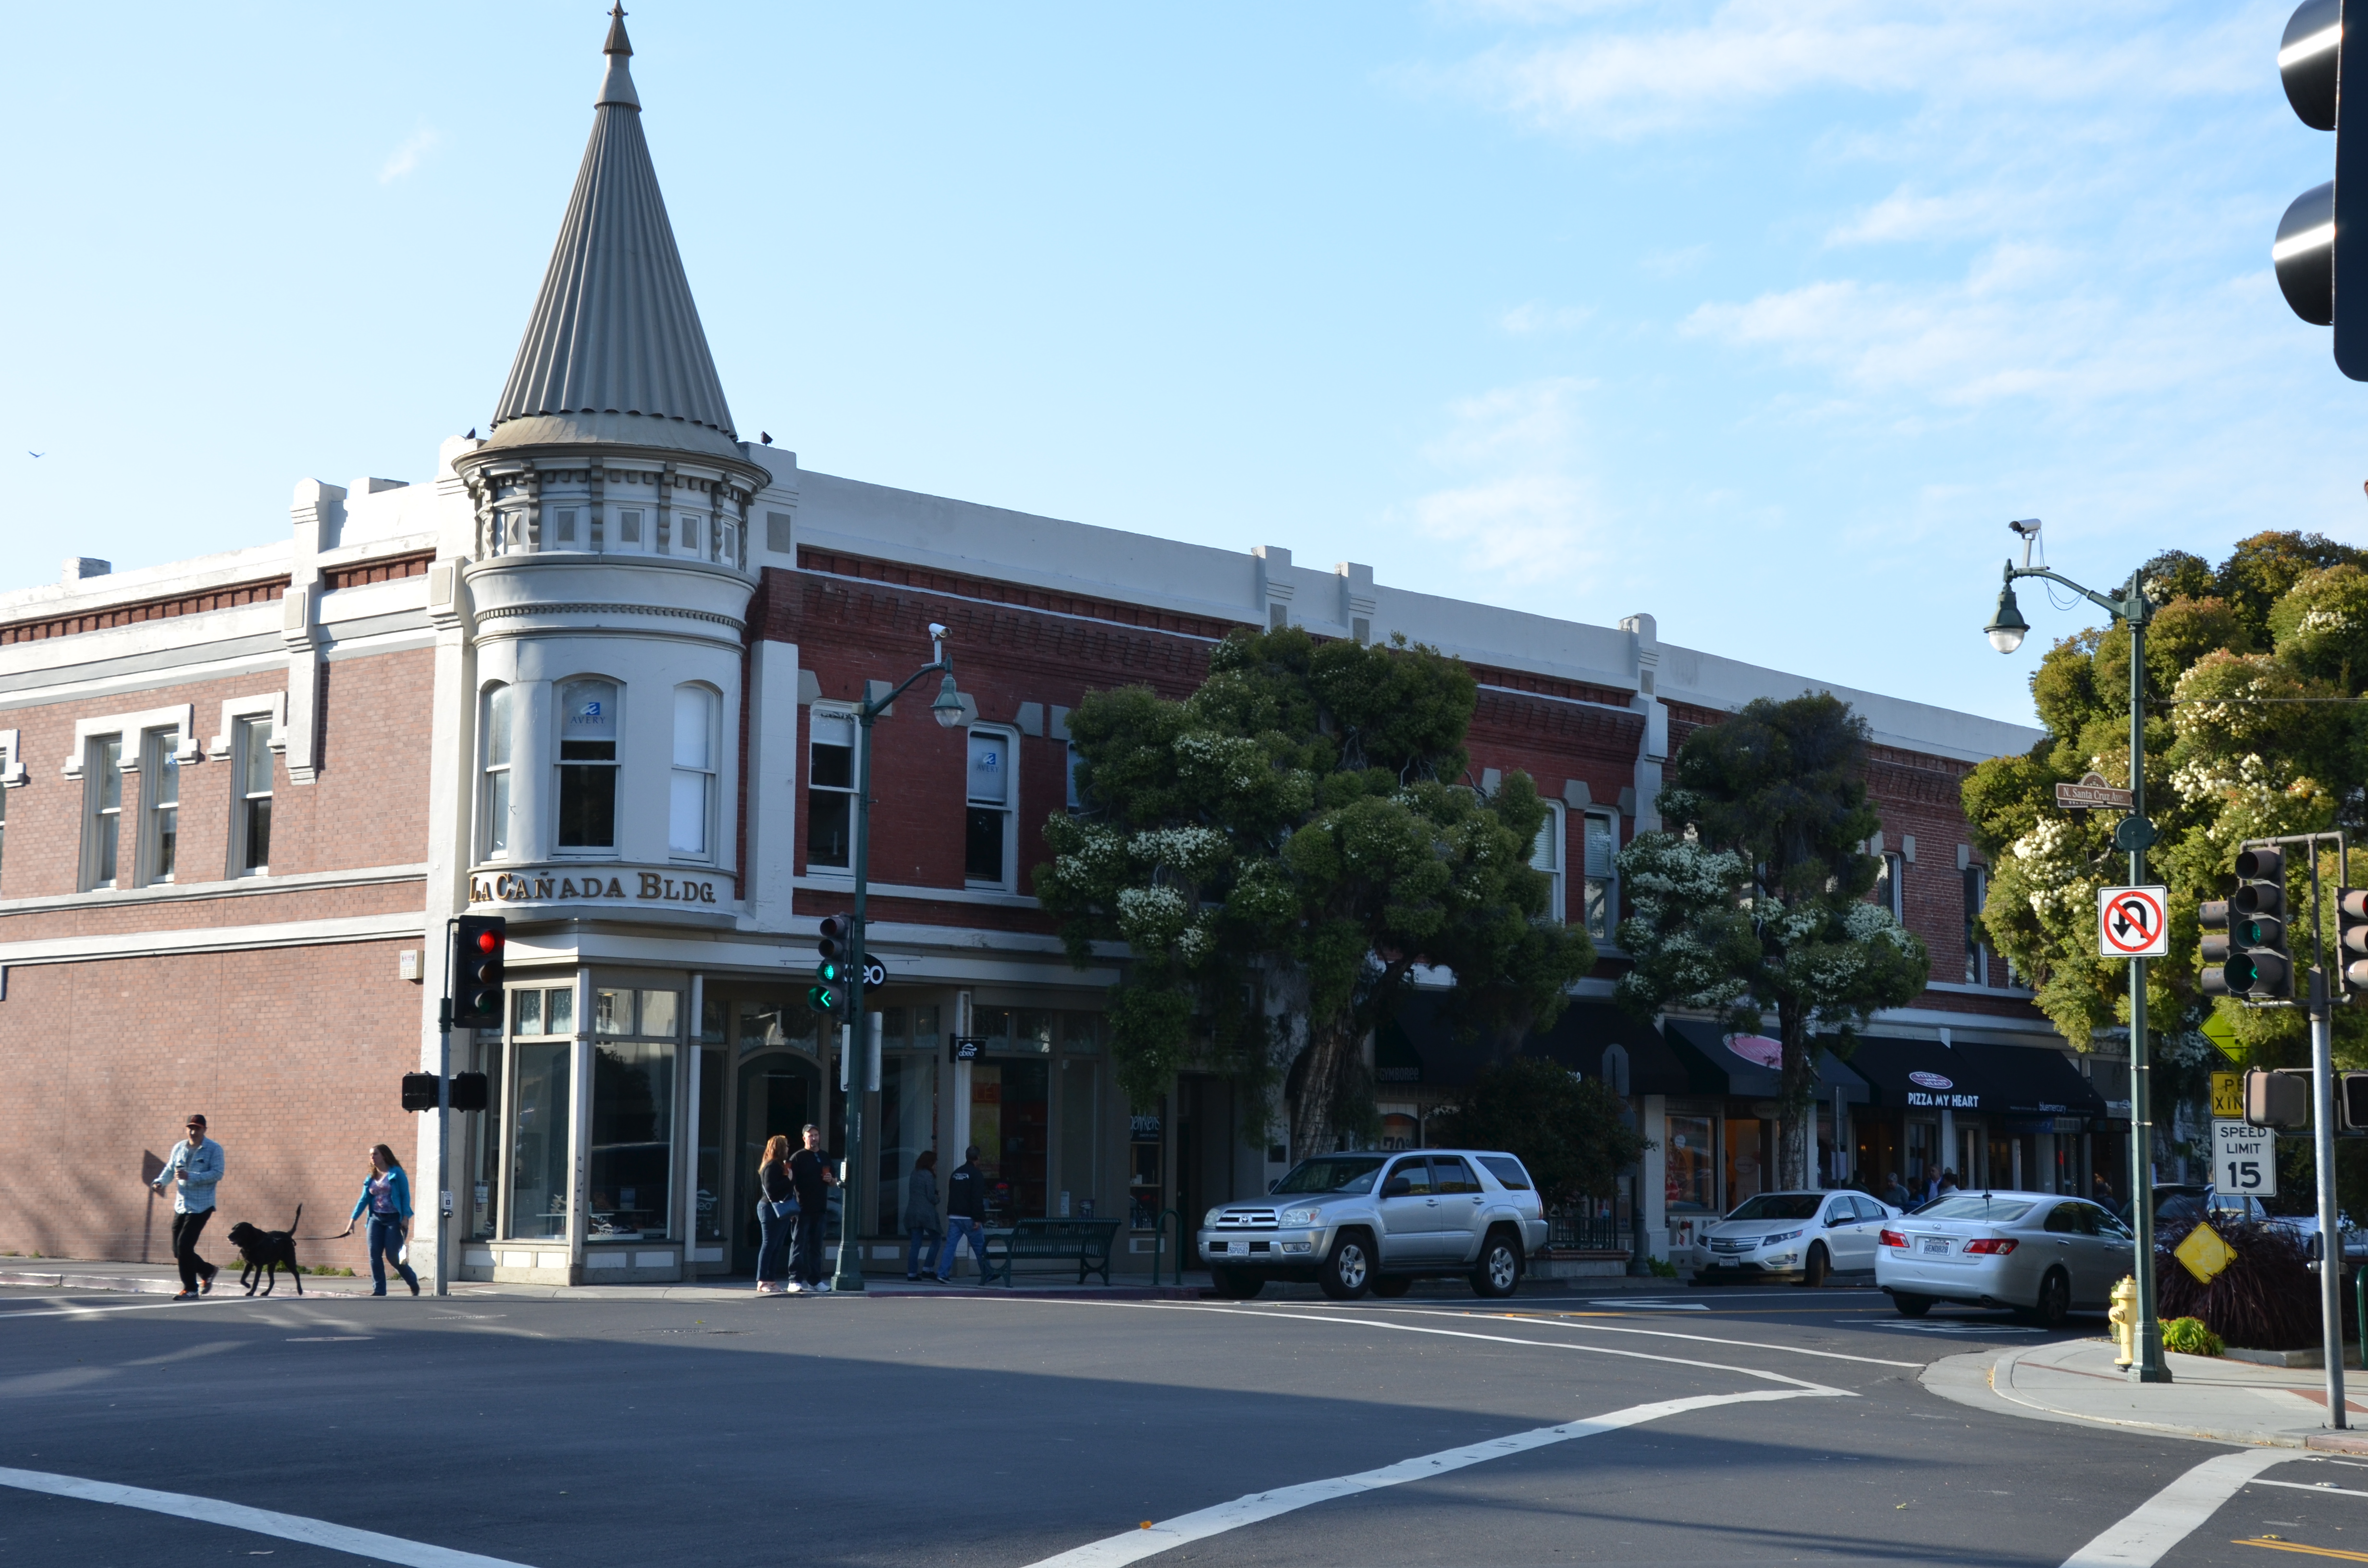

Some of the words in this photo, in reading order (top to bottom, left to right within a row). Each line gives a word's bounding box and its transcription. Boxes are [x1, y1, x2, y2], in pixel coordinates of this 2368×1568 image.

[976, 764, 999, 773] AVERY
[2063, 787, 2071, 797] N.
[2072, 788, 2092, 799] Santa
[2094, 790, 2110, 801] Cruz
[2111, 792, 2125, 803] Ave.
[495, 871, 626, 901] CAÑADA
[637, 872, 716, 904] BLDG.
[2224, 1079, 2244, 1092] PE
[1908, 1092, 1933, 1106] PIZZA
[1935, 1093, 1949, 1106] MY
[1951, 1094, 1979, 1108] HEART
[2215, 1096, 2244, 1110] XIN
[2038, 1101, 2067, 1115] bluemercury
[2220, 1127, 2267, 1138] SPEED
[2226, 1143, 2261, 1154] LIMIT
[2228, 1161, 2261, 1188] 15
[1924, 1244, 1948, 1253] 6END828
